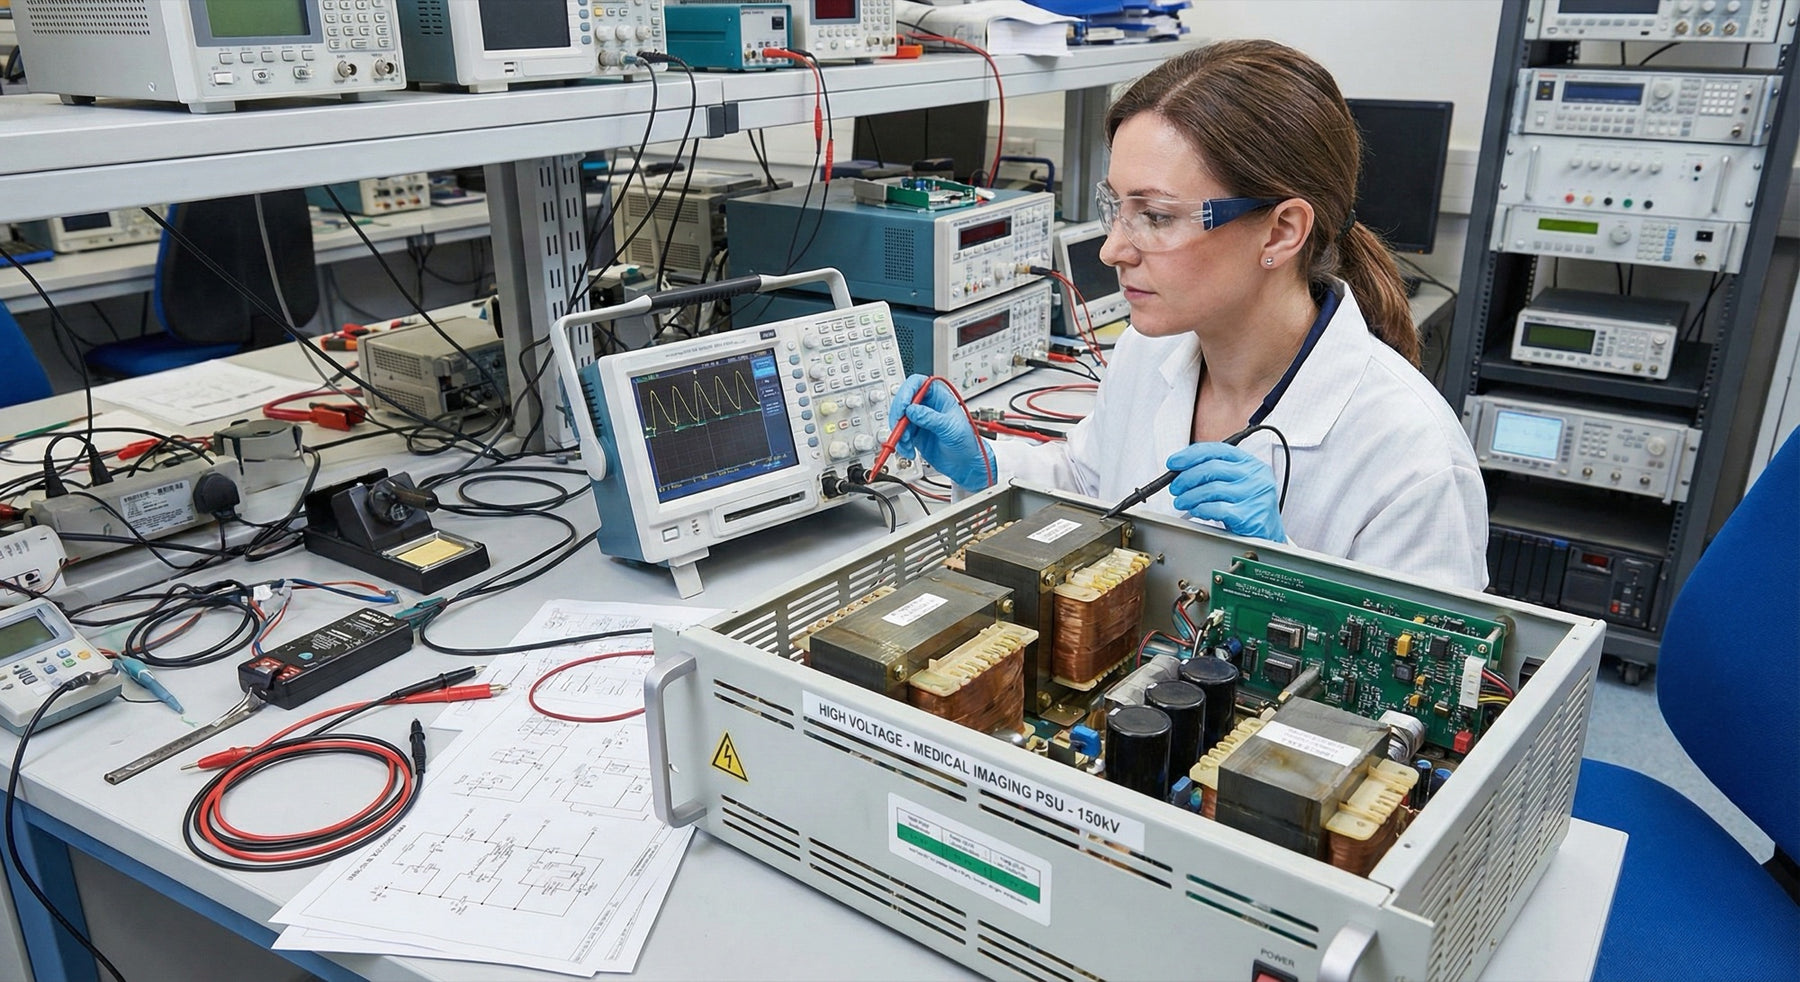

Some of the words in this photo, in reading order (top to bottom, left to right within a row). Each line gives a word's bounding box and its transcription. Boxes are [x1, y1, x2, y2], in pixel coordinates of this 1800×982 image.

[819, 702, 847, 725] HIGH
[849, 715, 903, 747] VOLTAGE
[914, 741, 969, 775] MEDICAL
[973, 765, 1032, 799] IMAGING
[1036, 790, 1064, 812] PSU
[1077, 807, 1121, 834] 150kV
[1261, 948, 1295, 968] POWER
